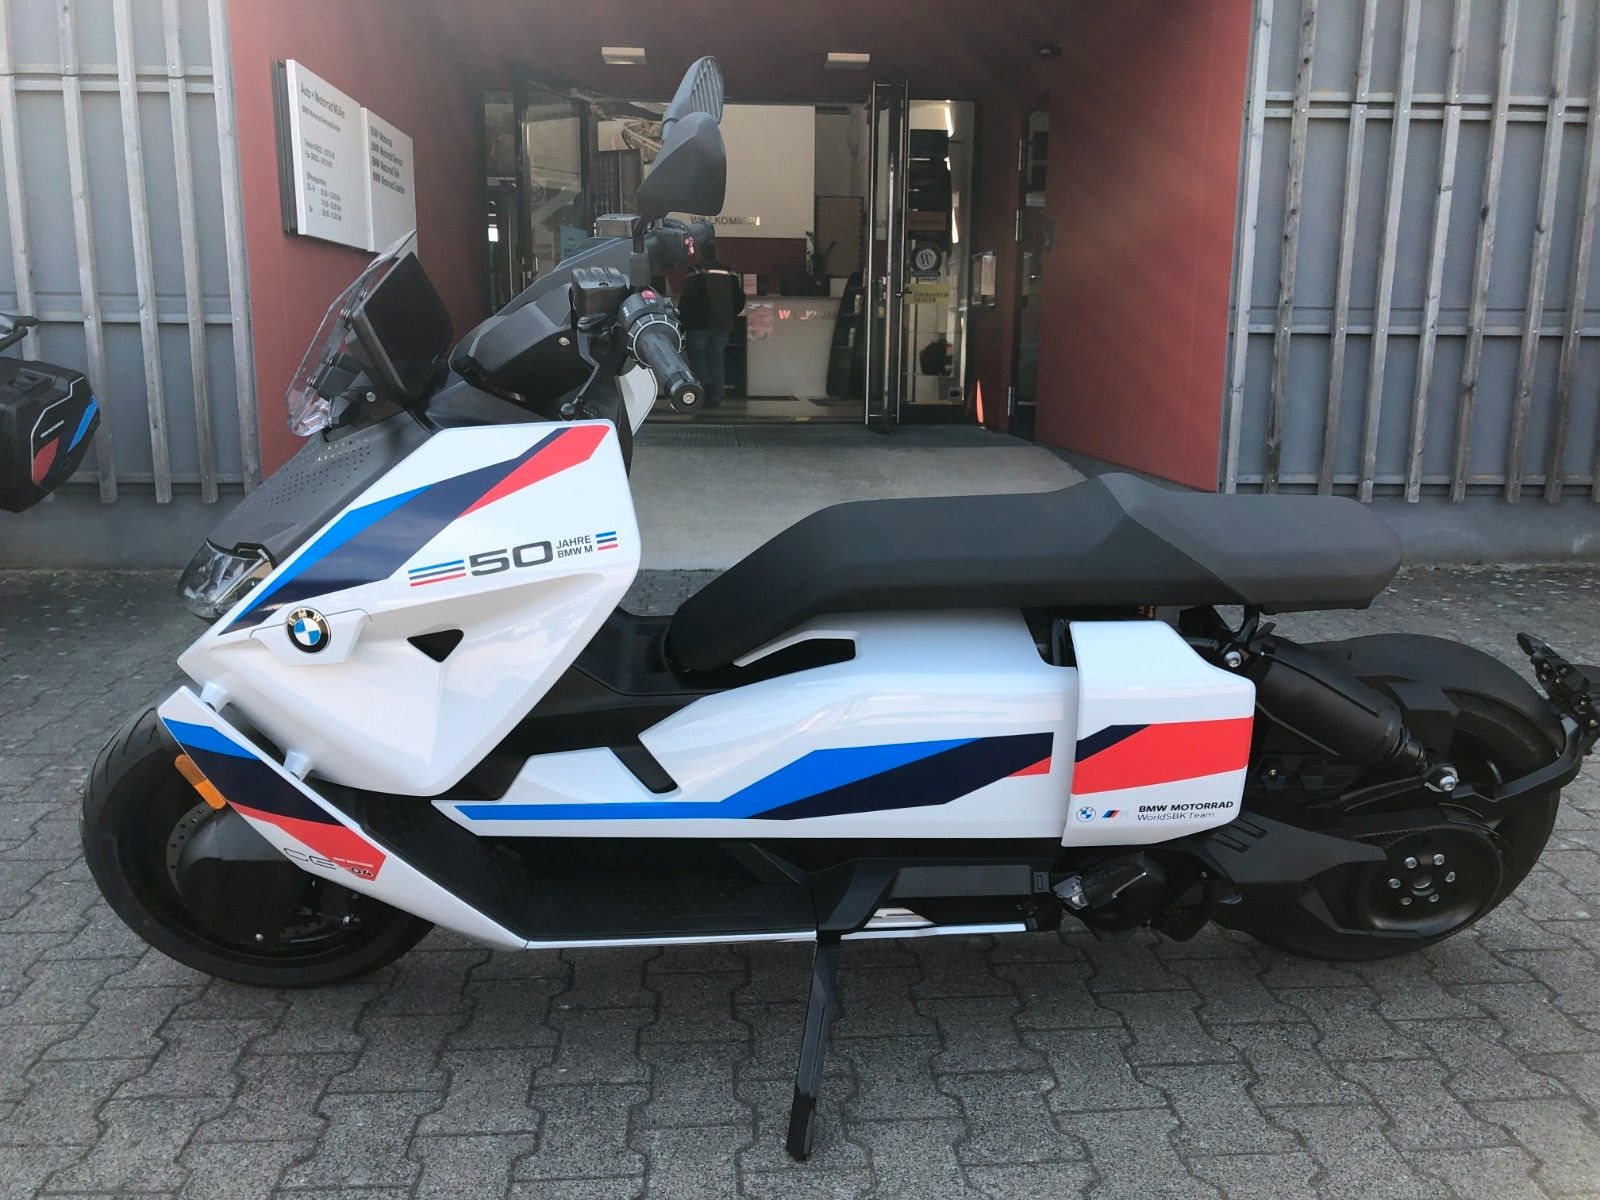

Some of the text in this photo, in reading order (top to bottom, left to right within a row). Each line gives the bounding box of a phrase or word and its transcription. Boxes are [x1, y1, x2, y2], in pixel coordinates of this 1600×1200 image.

[555, 535, 592, 550] JAHRE
[469, 540, 554, 577] 50
[557, 544, 594, 559] BMW M
[1138, 800, 1235, 813] BMW MOTORRAD
[1137, 811, 1216, 821] WorldSBK Team
[283, 847, 337, 870] CE
[350, 866, 374, 878] 04
